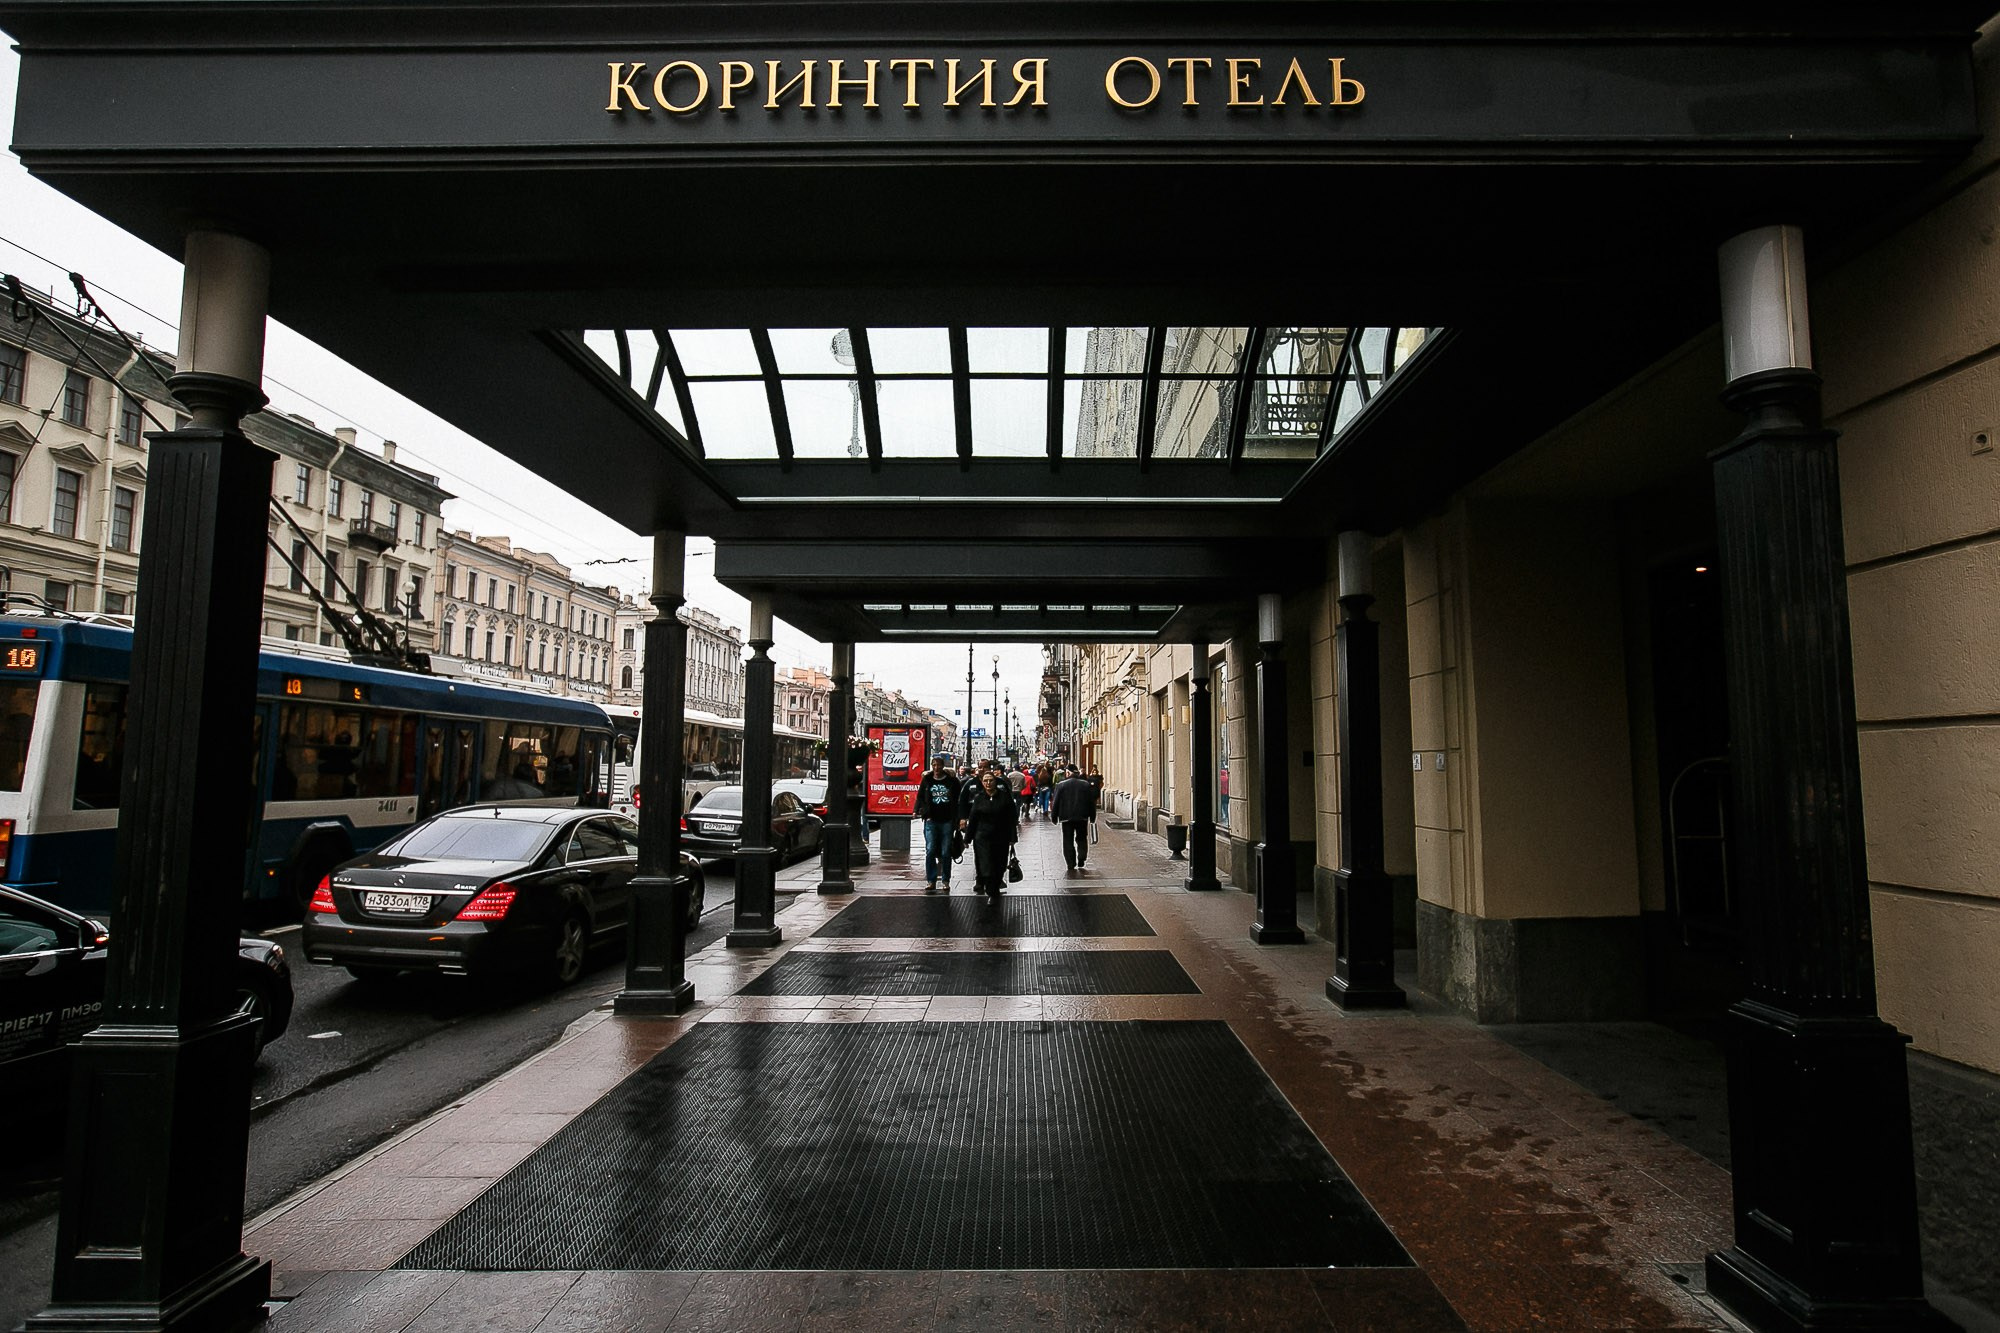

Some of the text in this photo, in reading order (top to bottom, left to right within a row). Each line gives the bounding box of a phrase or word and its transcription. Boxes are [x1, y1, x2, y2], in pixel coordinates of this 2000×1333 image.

[604, 56, 1366, 113] КОРИНТИЯ ОТЕЛЬ
[6, 648, 36, 667] 10
[287, 679, 302, 694] 10
[884, 753, 908, 765] Bud
[870, 783, 886, 791] ТВОЙ
[413, 896, 428, 905] 178
[61, 1002, 102, 1020] ПМЭФ
